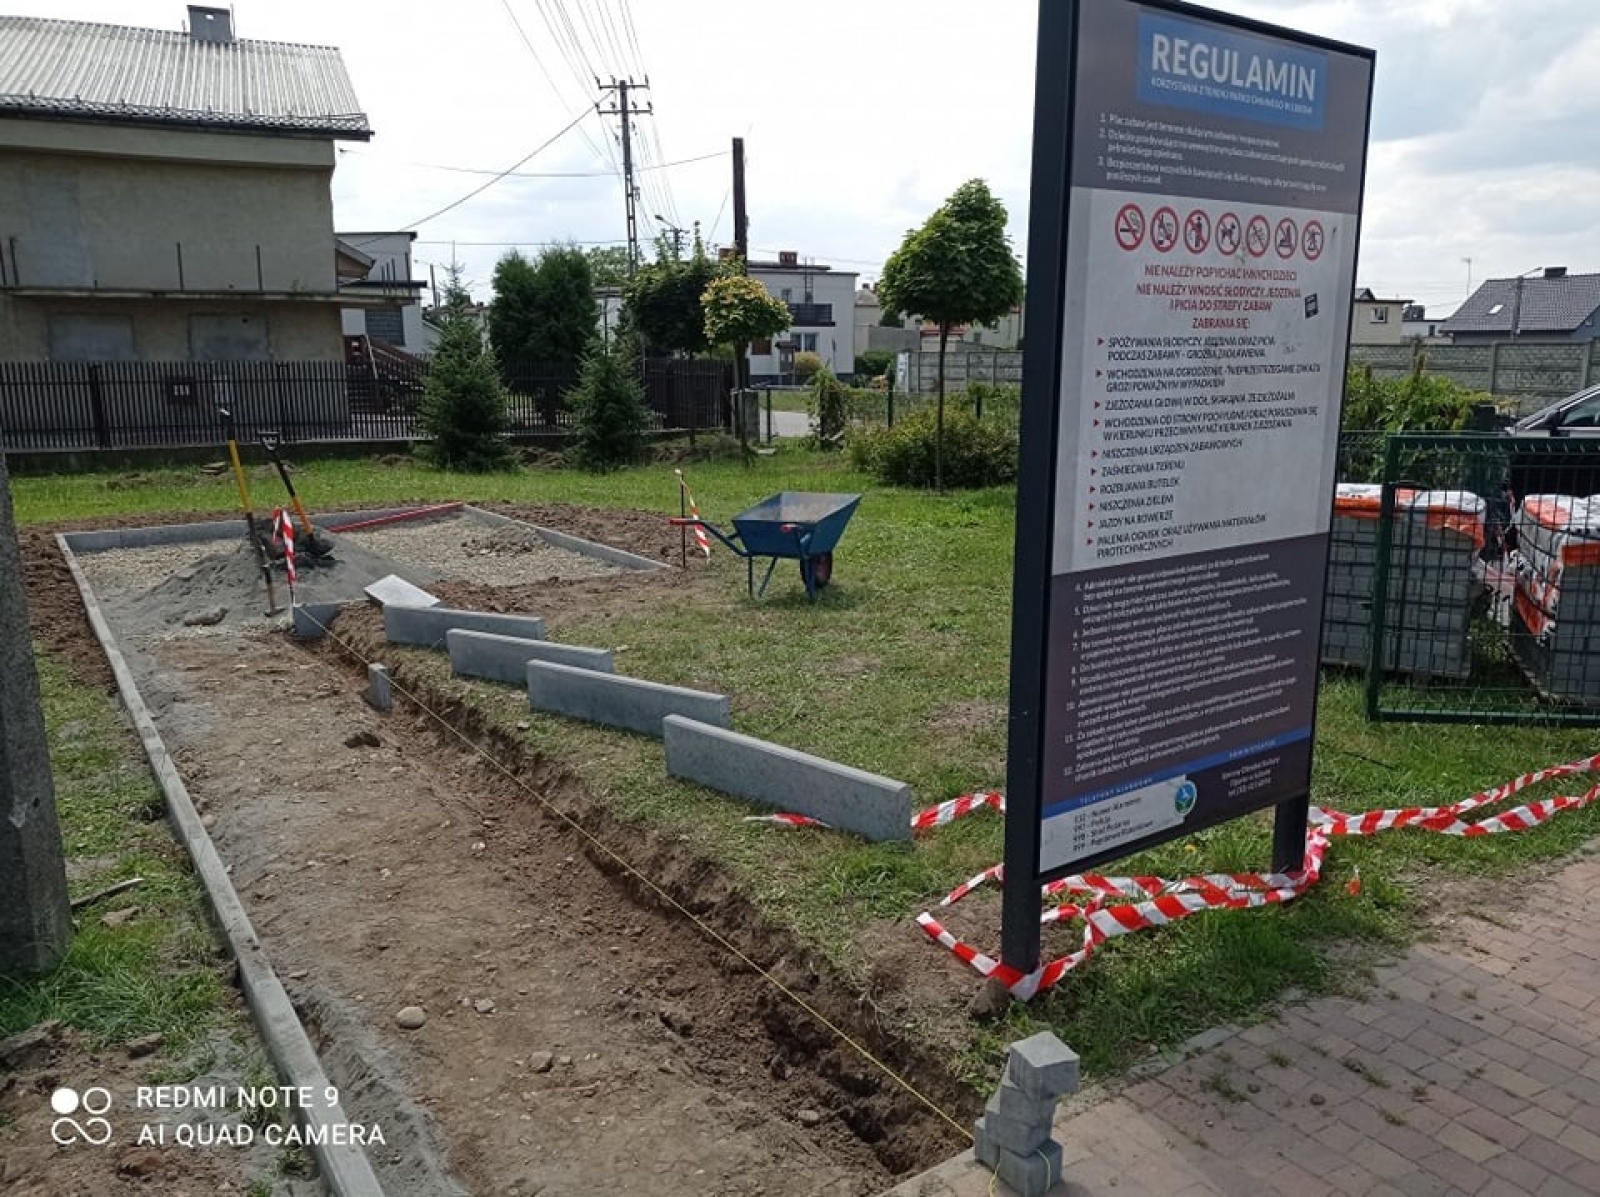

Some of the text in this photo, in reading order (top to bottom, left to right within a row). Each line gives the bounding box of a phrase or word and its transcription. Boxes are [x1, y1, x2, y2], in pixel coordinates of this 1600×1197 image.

[1151, 32, 1316, 101] REGULAMIN
[1144, 263, 1160, 275] NIE
[1136, 282, 1150, 294] NIE
[1153, 283, 1186, 295] NALEŻY
[1199, 299, 1211, 311] DO
[1243, 300, 1272, 312] ZABAW
[1192, 317, 1234, 329] ZABRANIA
